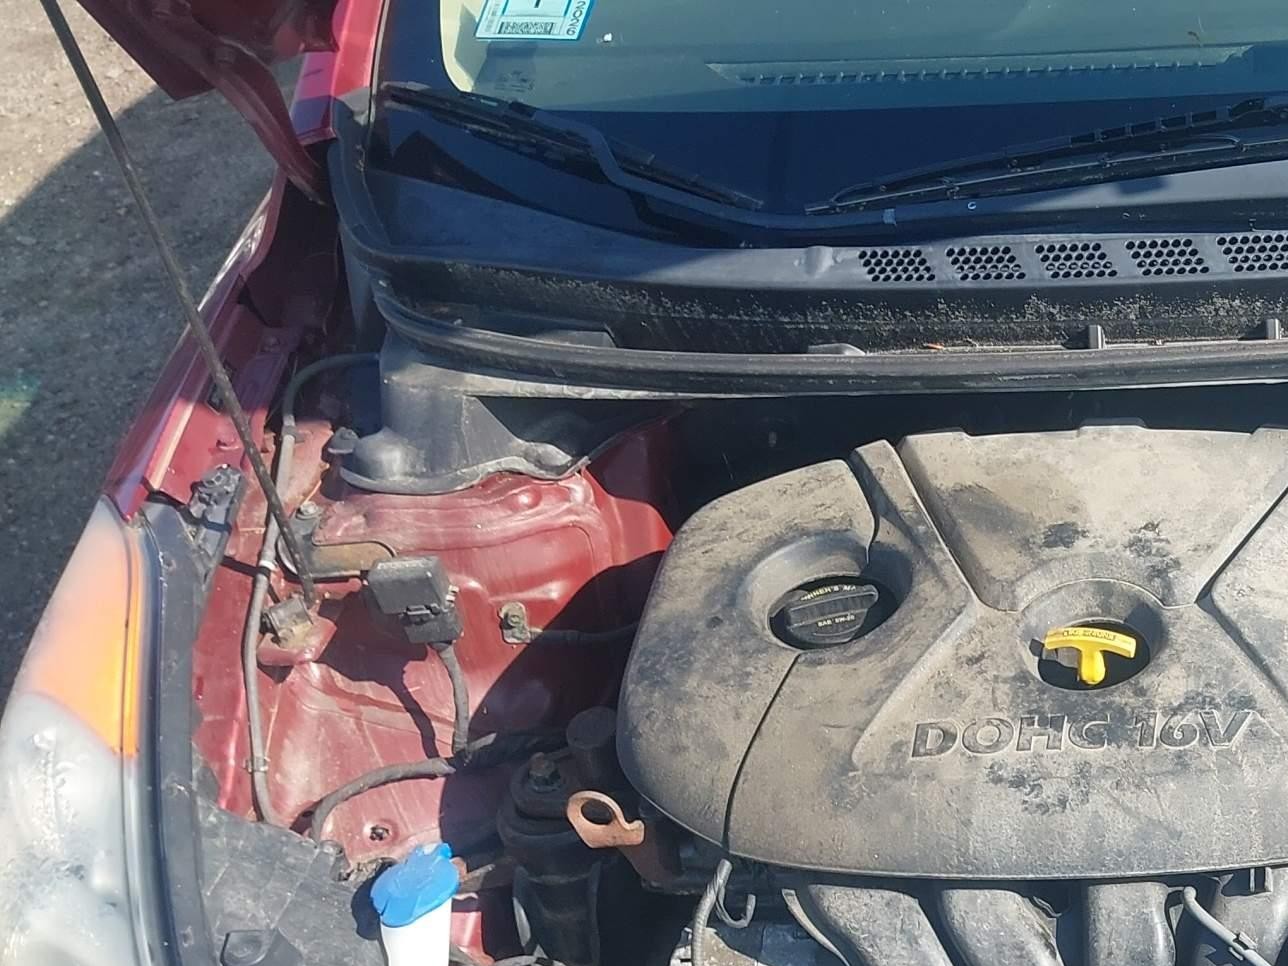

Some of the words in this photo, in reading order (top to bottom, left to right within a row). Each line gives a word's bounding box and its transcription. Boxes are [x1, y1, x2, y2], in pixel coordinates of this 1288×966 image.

[565, 1, 586, 36] 2026
[911, 713, 1110, 758] DOHC
[1133, 708, 1253, 750] 16V
